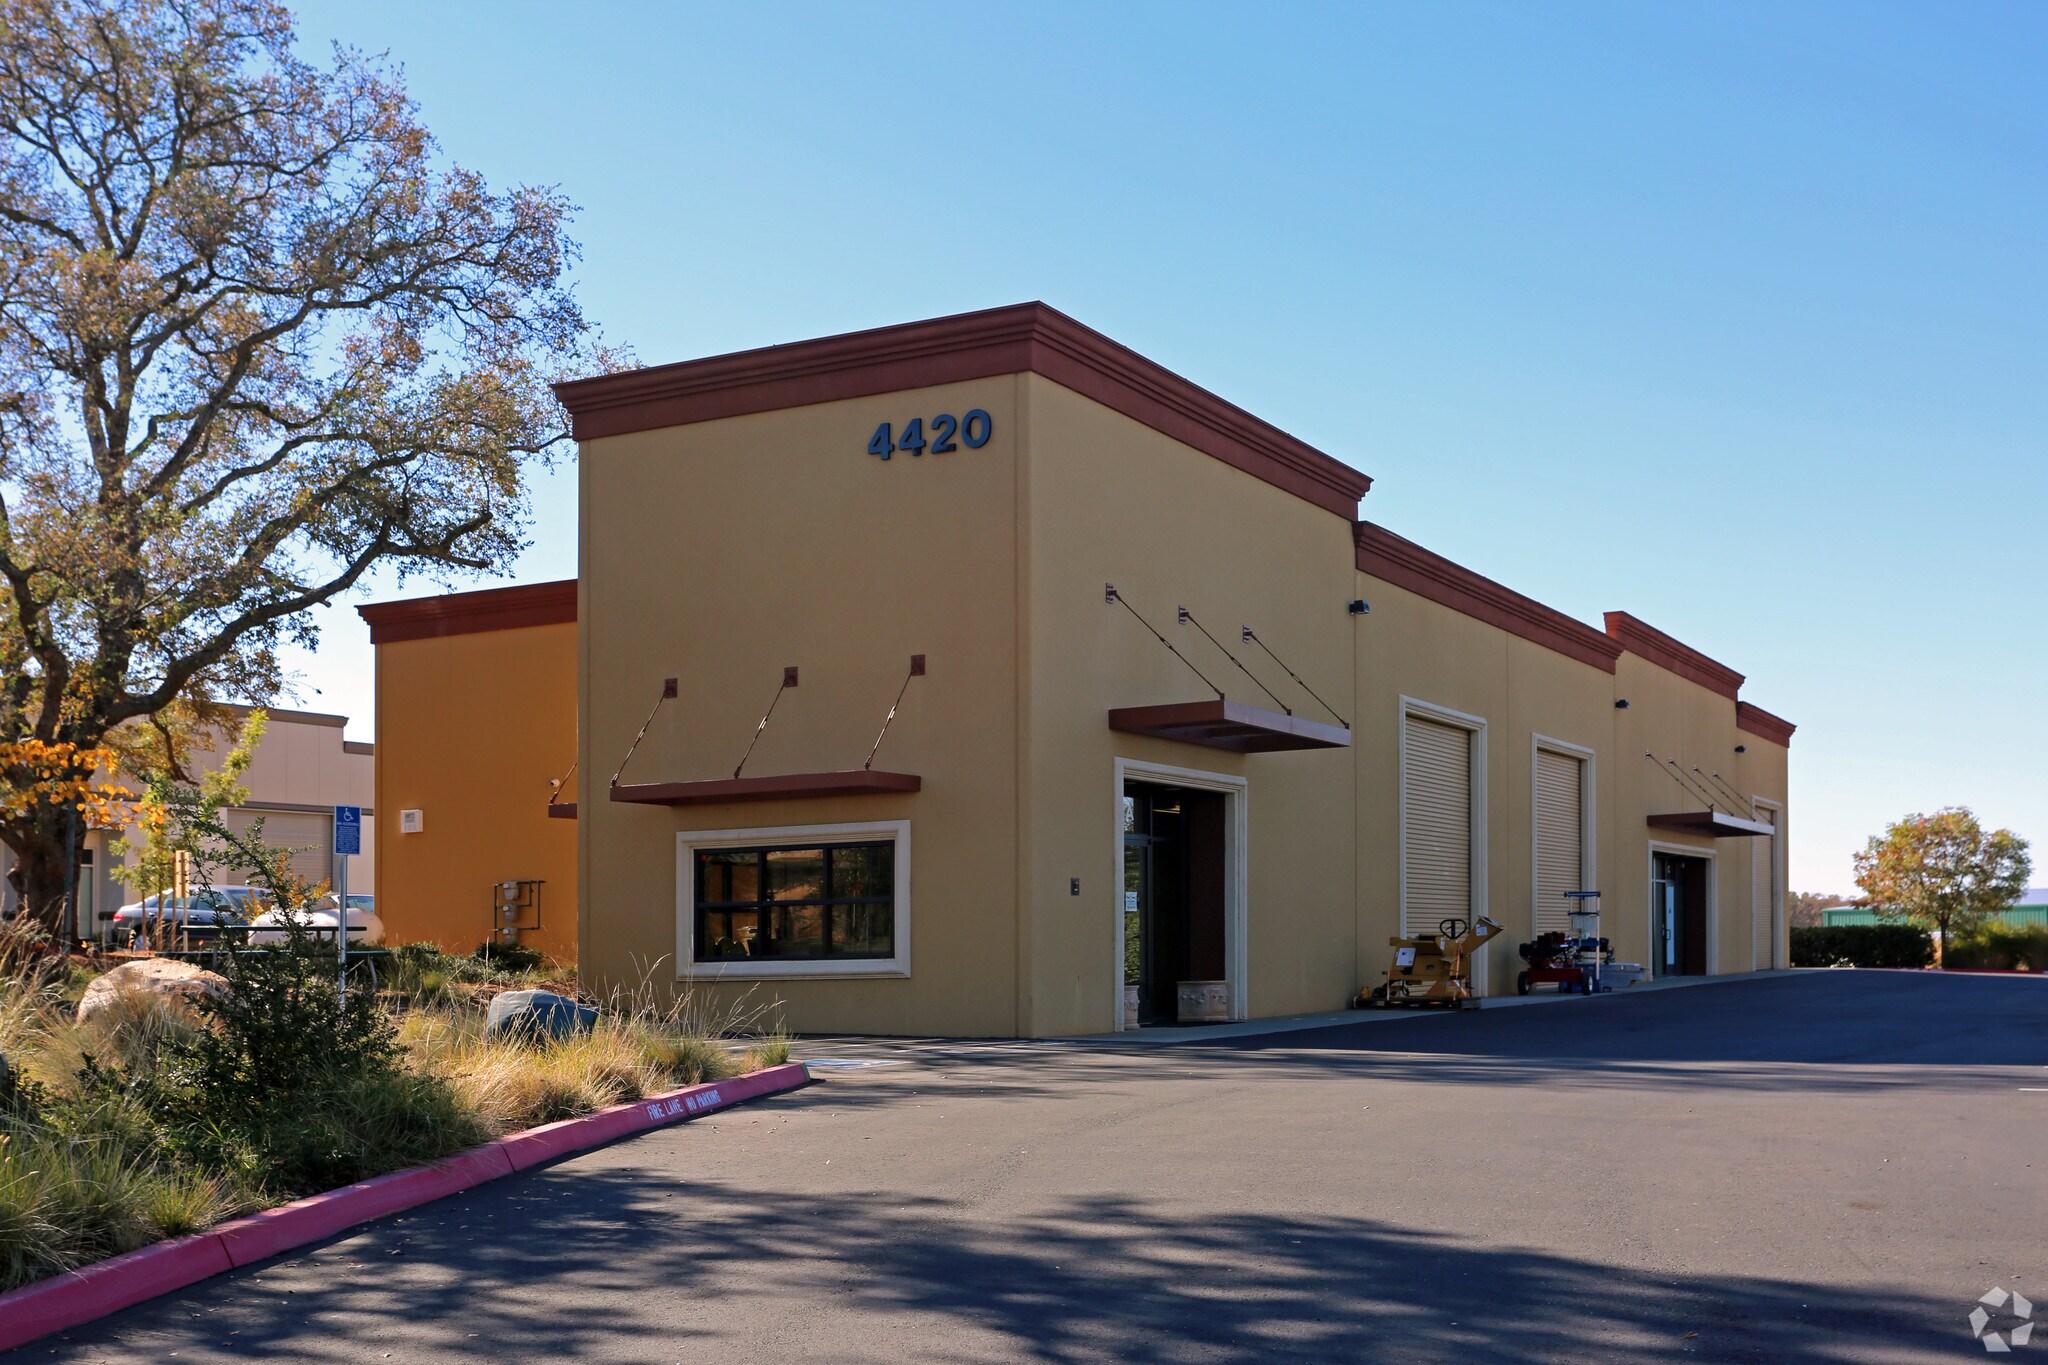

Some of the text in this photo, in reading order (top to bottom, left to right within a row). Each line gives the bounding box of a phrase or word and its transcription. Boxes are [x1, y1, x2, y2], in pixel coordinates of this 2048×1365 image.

[867, 408, 992, 461] 4420
[647, 1089, 721, 1120] FIRE LANE NO PARKING
